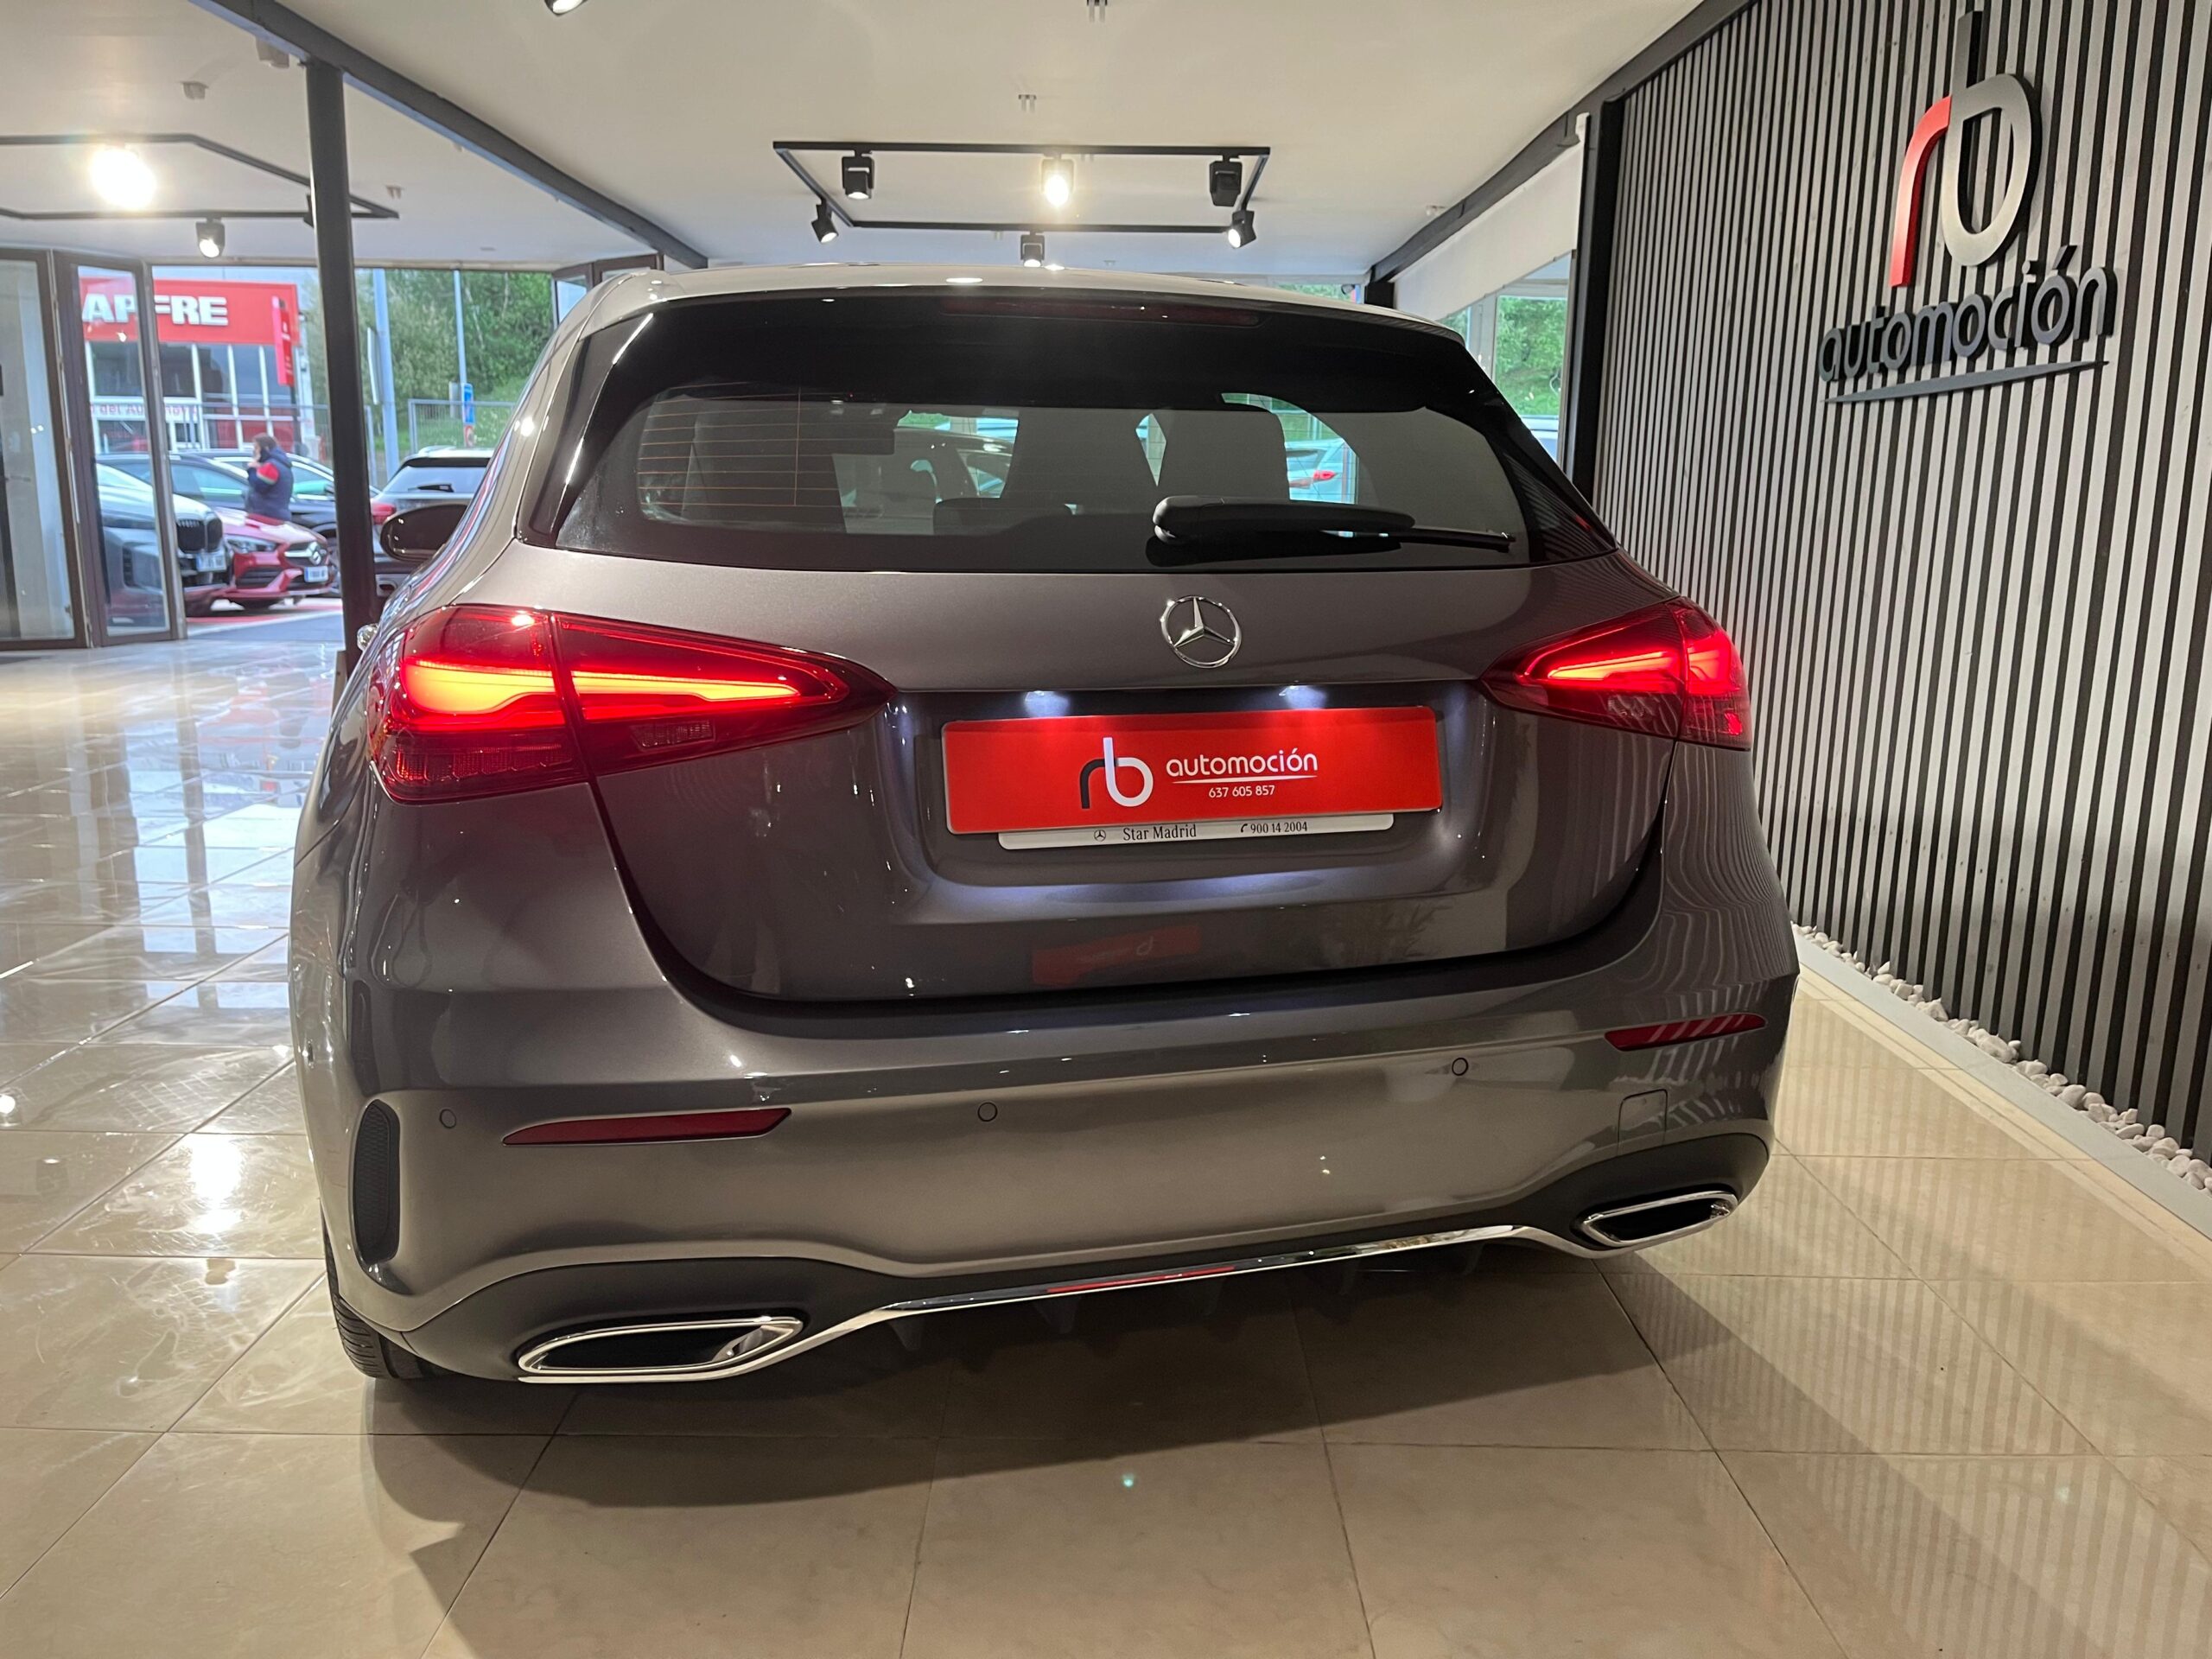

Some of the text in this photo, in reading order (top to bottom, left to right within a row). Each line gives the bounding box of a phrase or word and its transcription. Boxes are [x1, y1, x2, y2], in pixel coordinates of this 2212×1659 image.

[82, 293, 228, 326] APFRE
[1818, 245, 2117, 382] automoción
[1080, 737, 1154, 809] rb
[1166, 747, 1319, 777] automoción
[1208, 785, 1275, 798] 637 605 857
[1122, 822, 1308, 842] Star Madrid 900 14 2004
